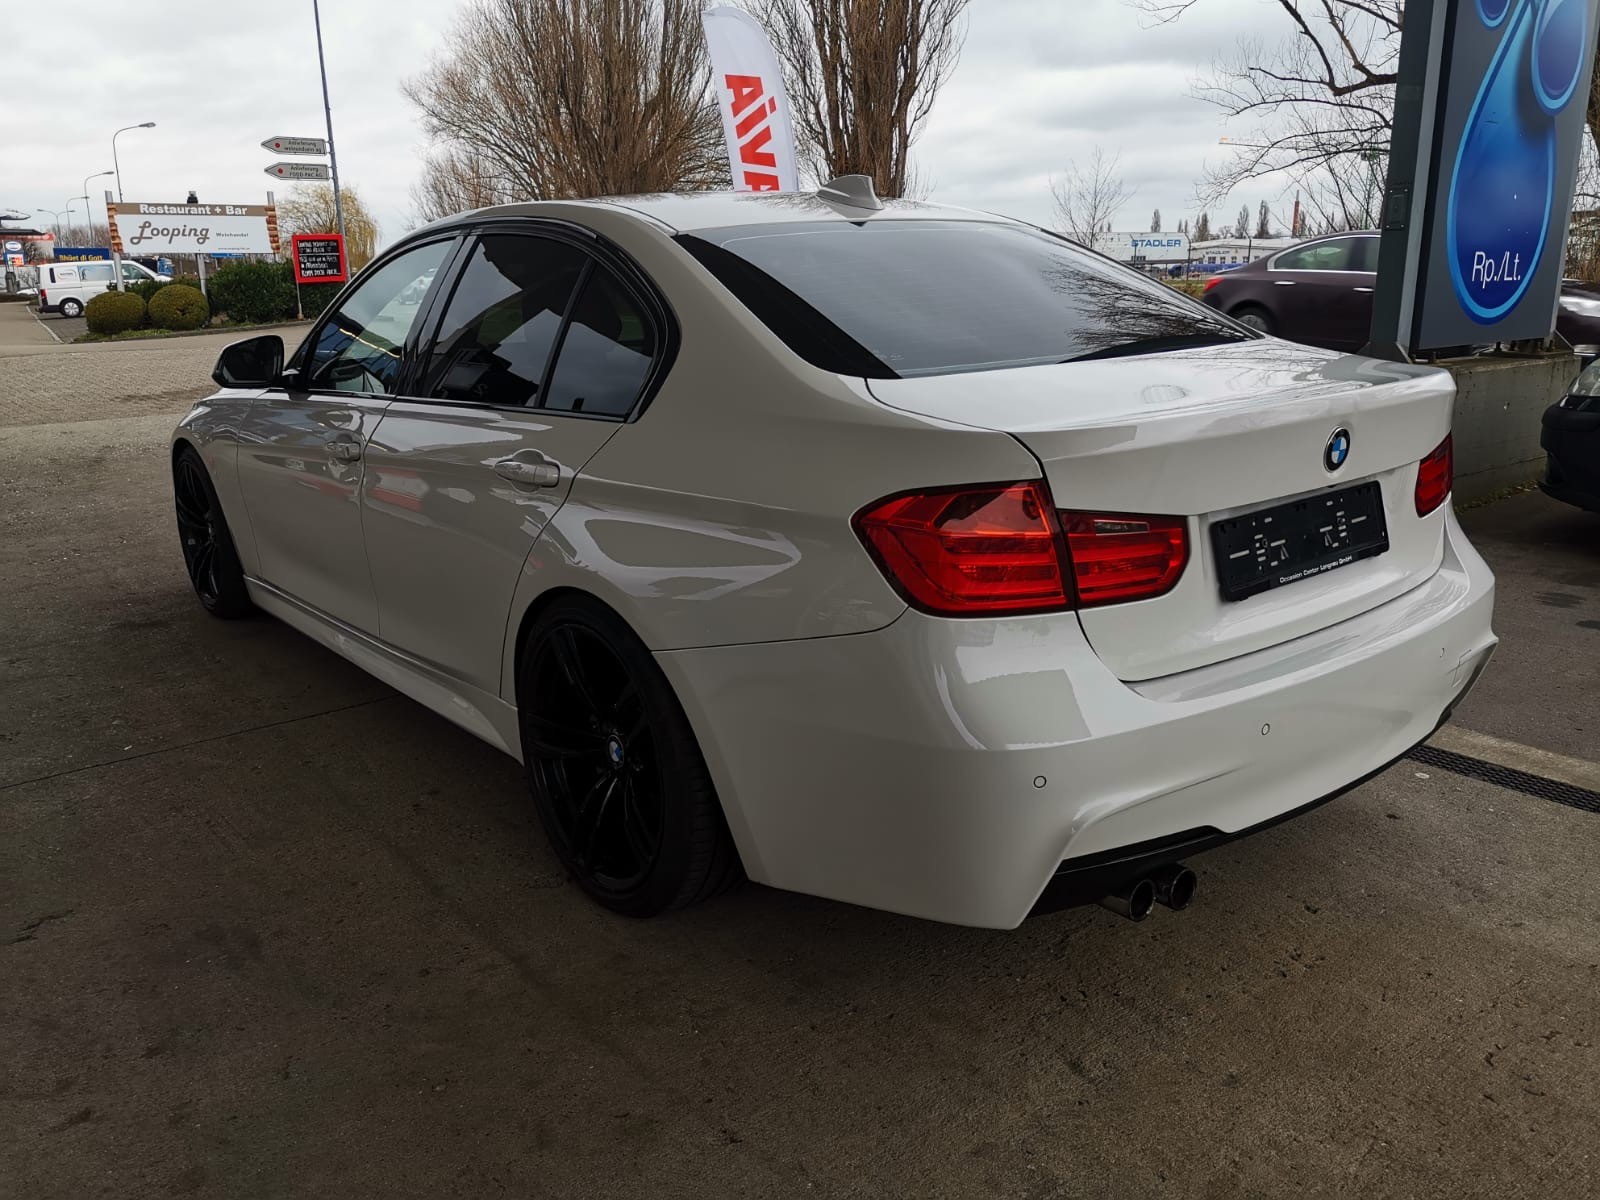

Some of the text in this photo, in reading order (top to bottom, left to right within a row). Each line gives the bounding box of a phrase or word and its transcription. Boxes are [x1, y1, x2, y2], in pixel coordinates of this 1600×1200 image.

[139, 203, 211, 215] Restaurant
[225, 205, 248, 215] Bar
[130, 220, 210, 246] Looping
[1131, 239, 1181, 247] STADLER
[1472, 251, 1521, 289] Rp./Lt.
[1280, 572, 1303, 583] Occasion
[1339, 555, 1353, 564] GmbH
